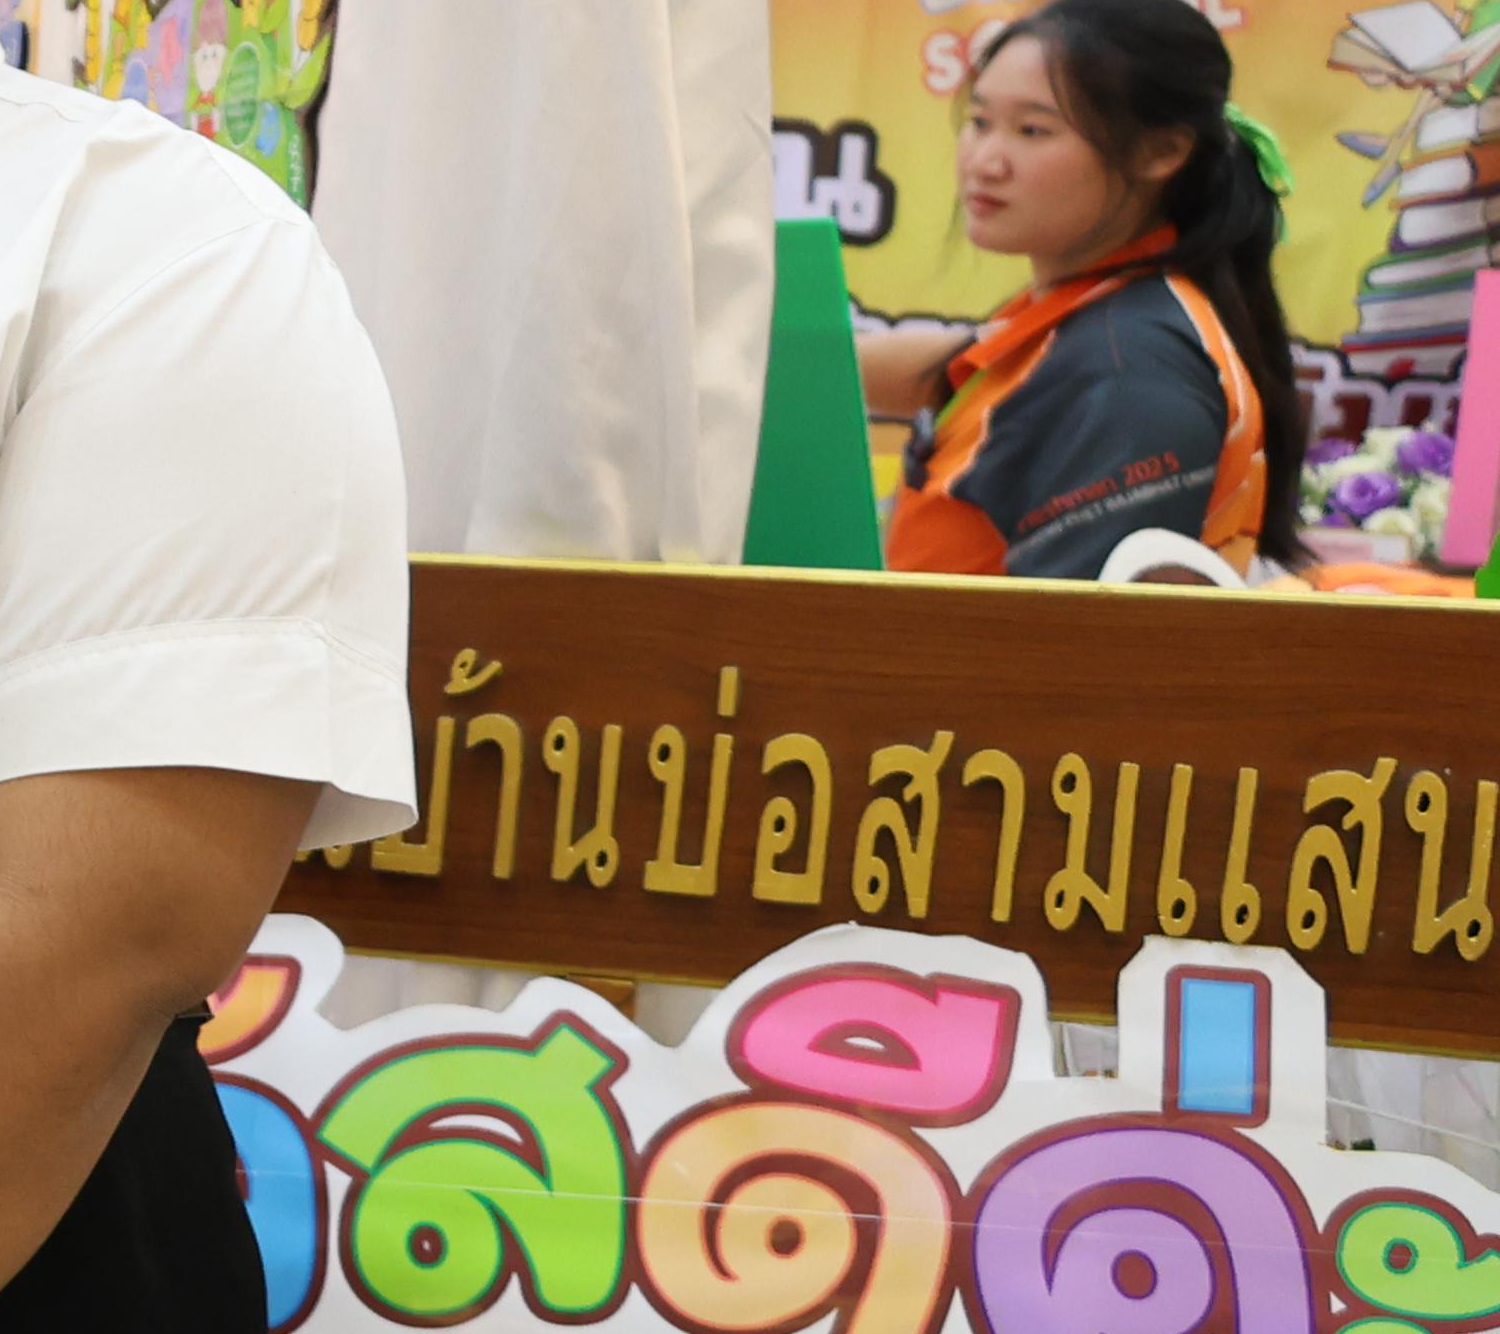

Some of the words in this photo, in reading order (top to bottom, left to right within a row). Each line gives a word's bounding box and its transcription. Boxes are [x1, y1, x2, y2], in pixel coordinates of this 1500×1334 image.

[293, 646, 1499, 962] บ้านบ่อสามแสน
